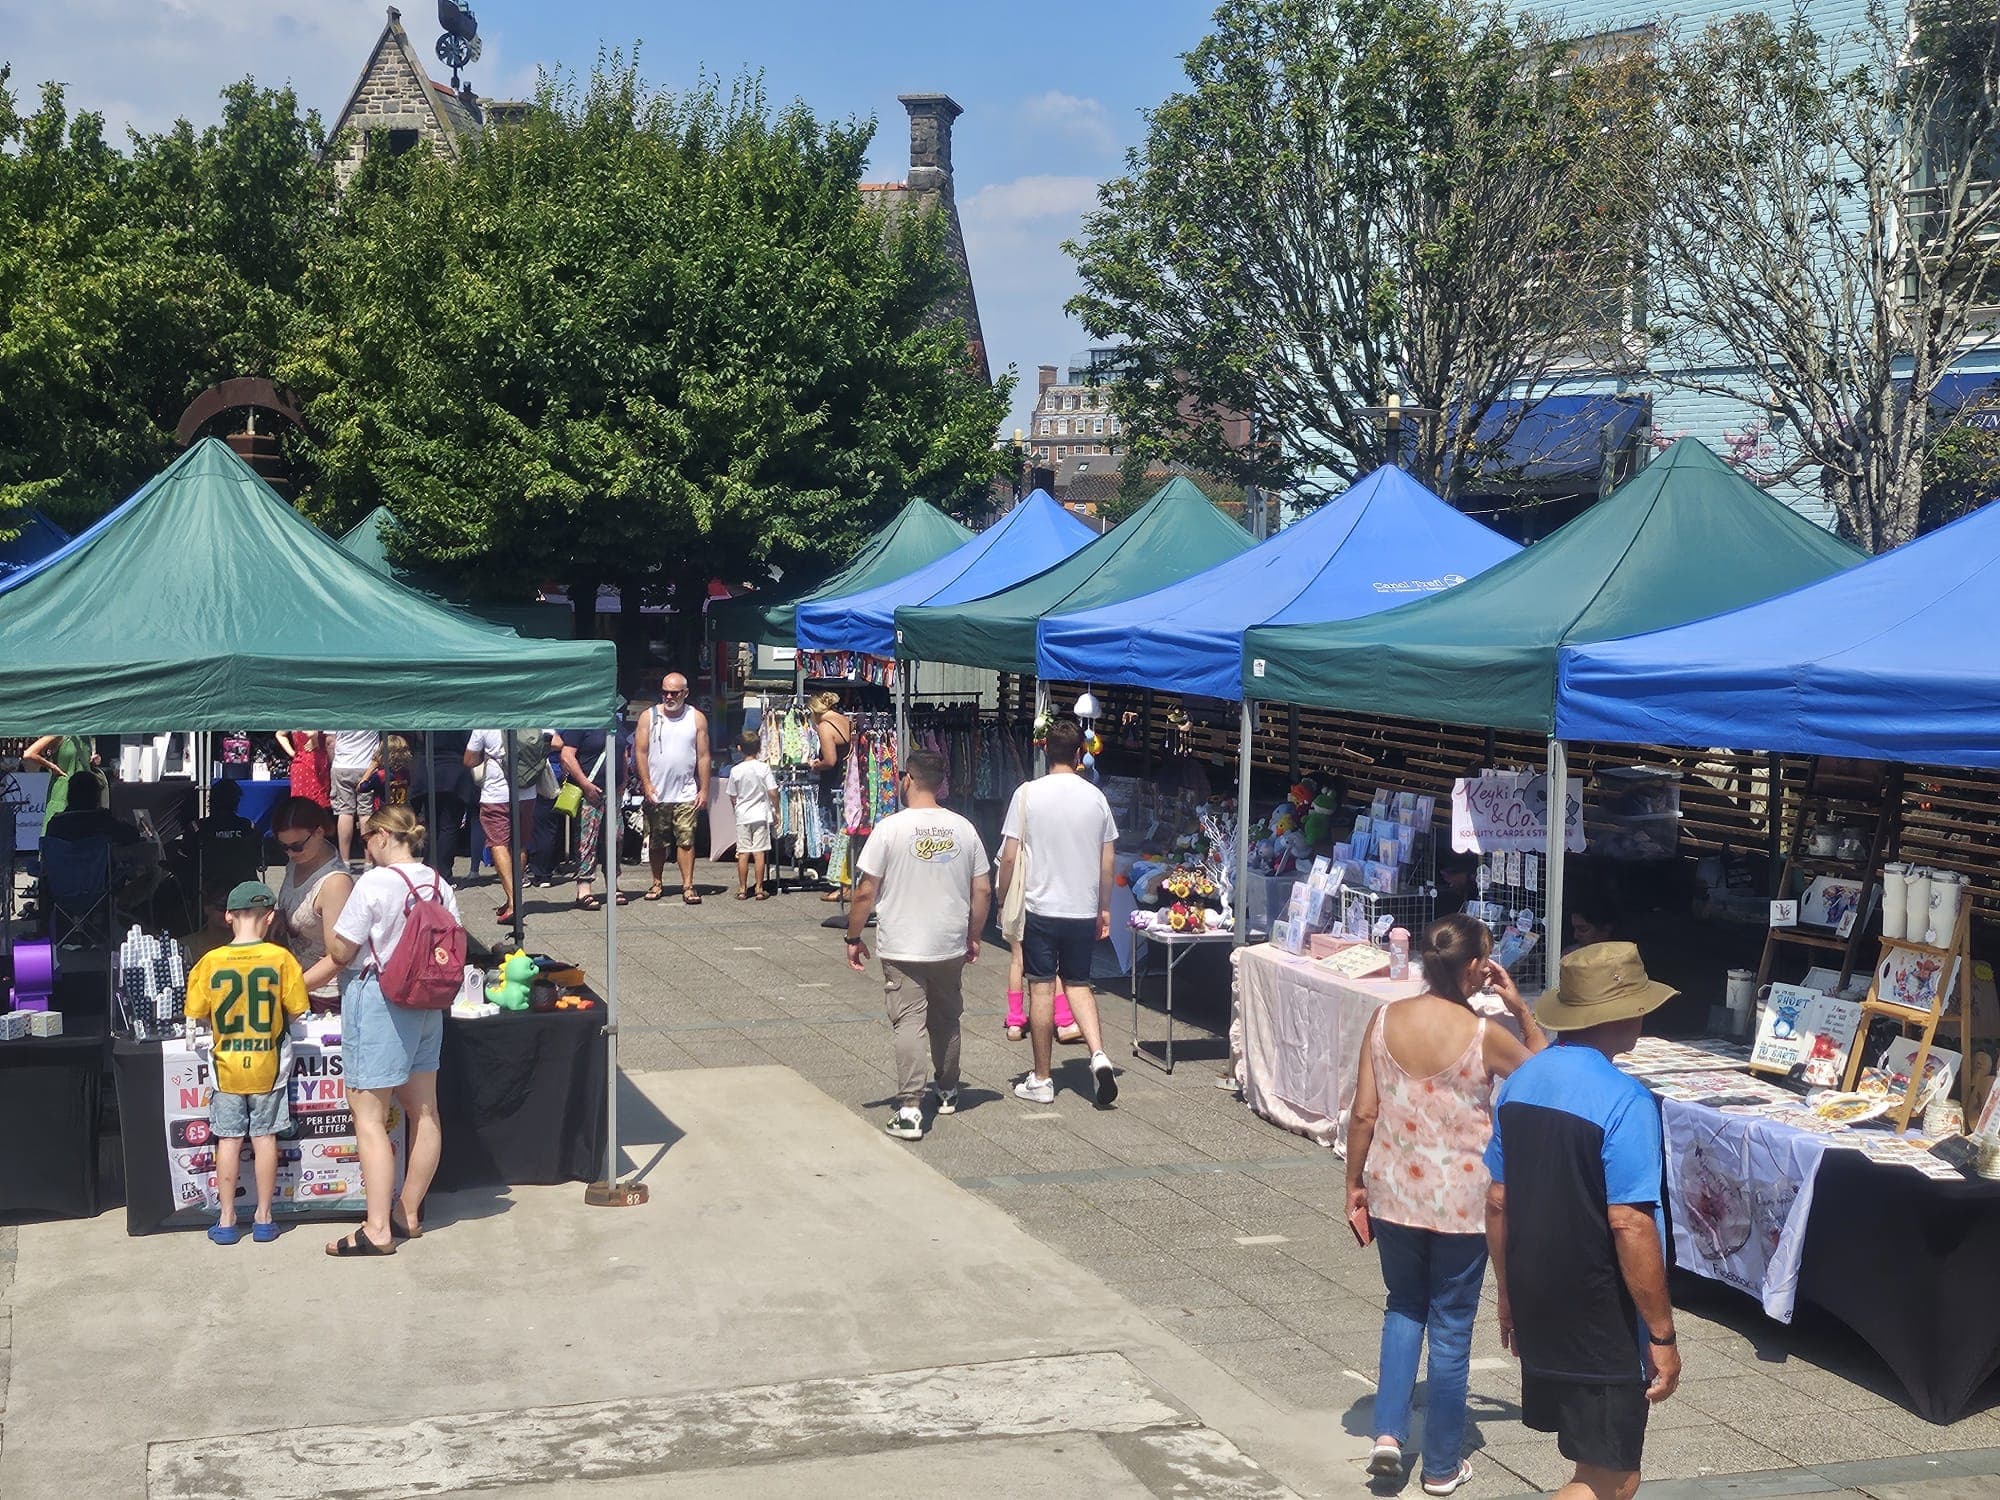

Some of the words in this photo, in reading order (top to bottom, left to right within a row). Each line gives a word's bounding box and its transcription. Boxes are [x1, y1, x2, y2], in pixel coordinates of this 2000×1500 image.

[1456, 781, 1509, 815] Keyki
[1506, 803, 1535, 828] Co.
[915, 826, 930, 836] Just
[1496, 829, 1524, 837] CARDS
[915, 838, 955, 859] Love
[211, 967, 279, 1034] 26
[1776, 995, 1812, 1008] SHORT
[306, 1116, 323, 1125] PER
[325, 1114, 353, 1124] EXTRA
[187, 1126, 206, 1139] £5
[314, 1124, 346, 1134] LETTER
